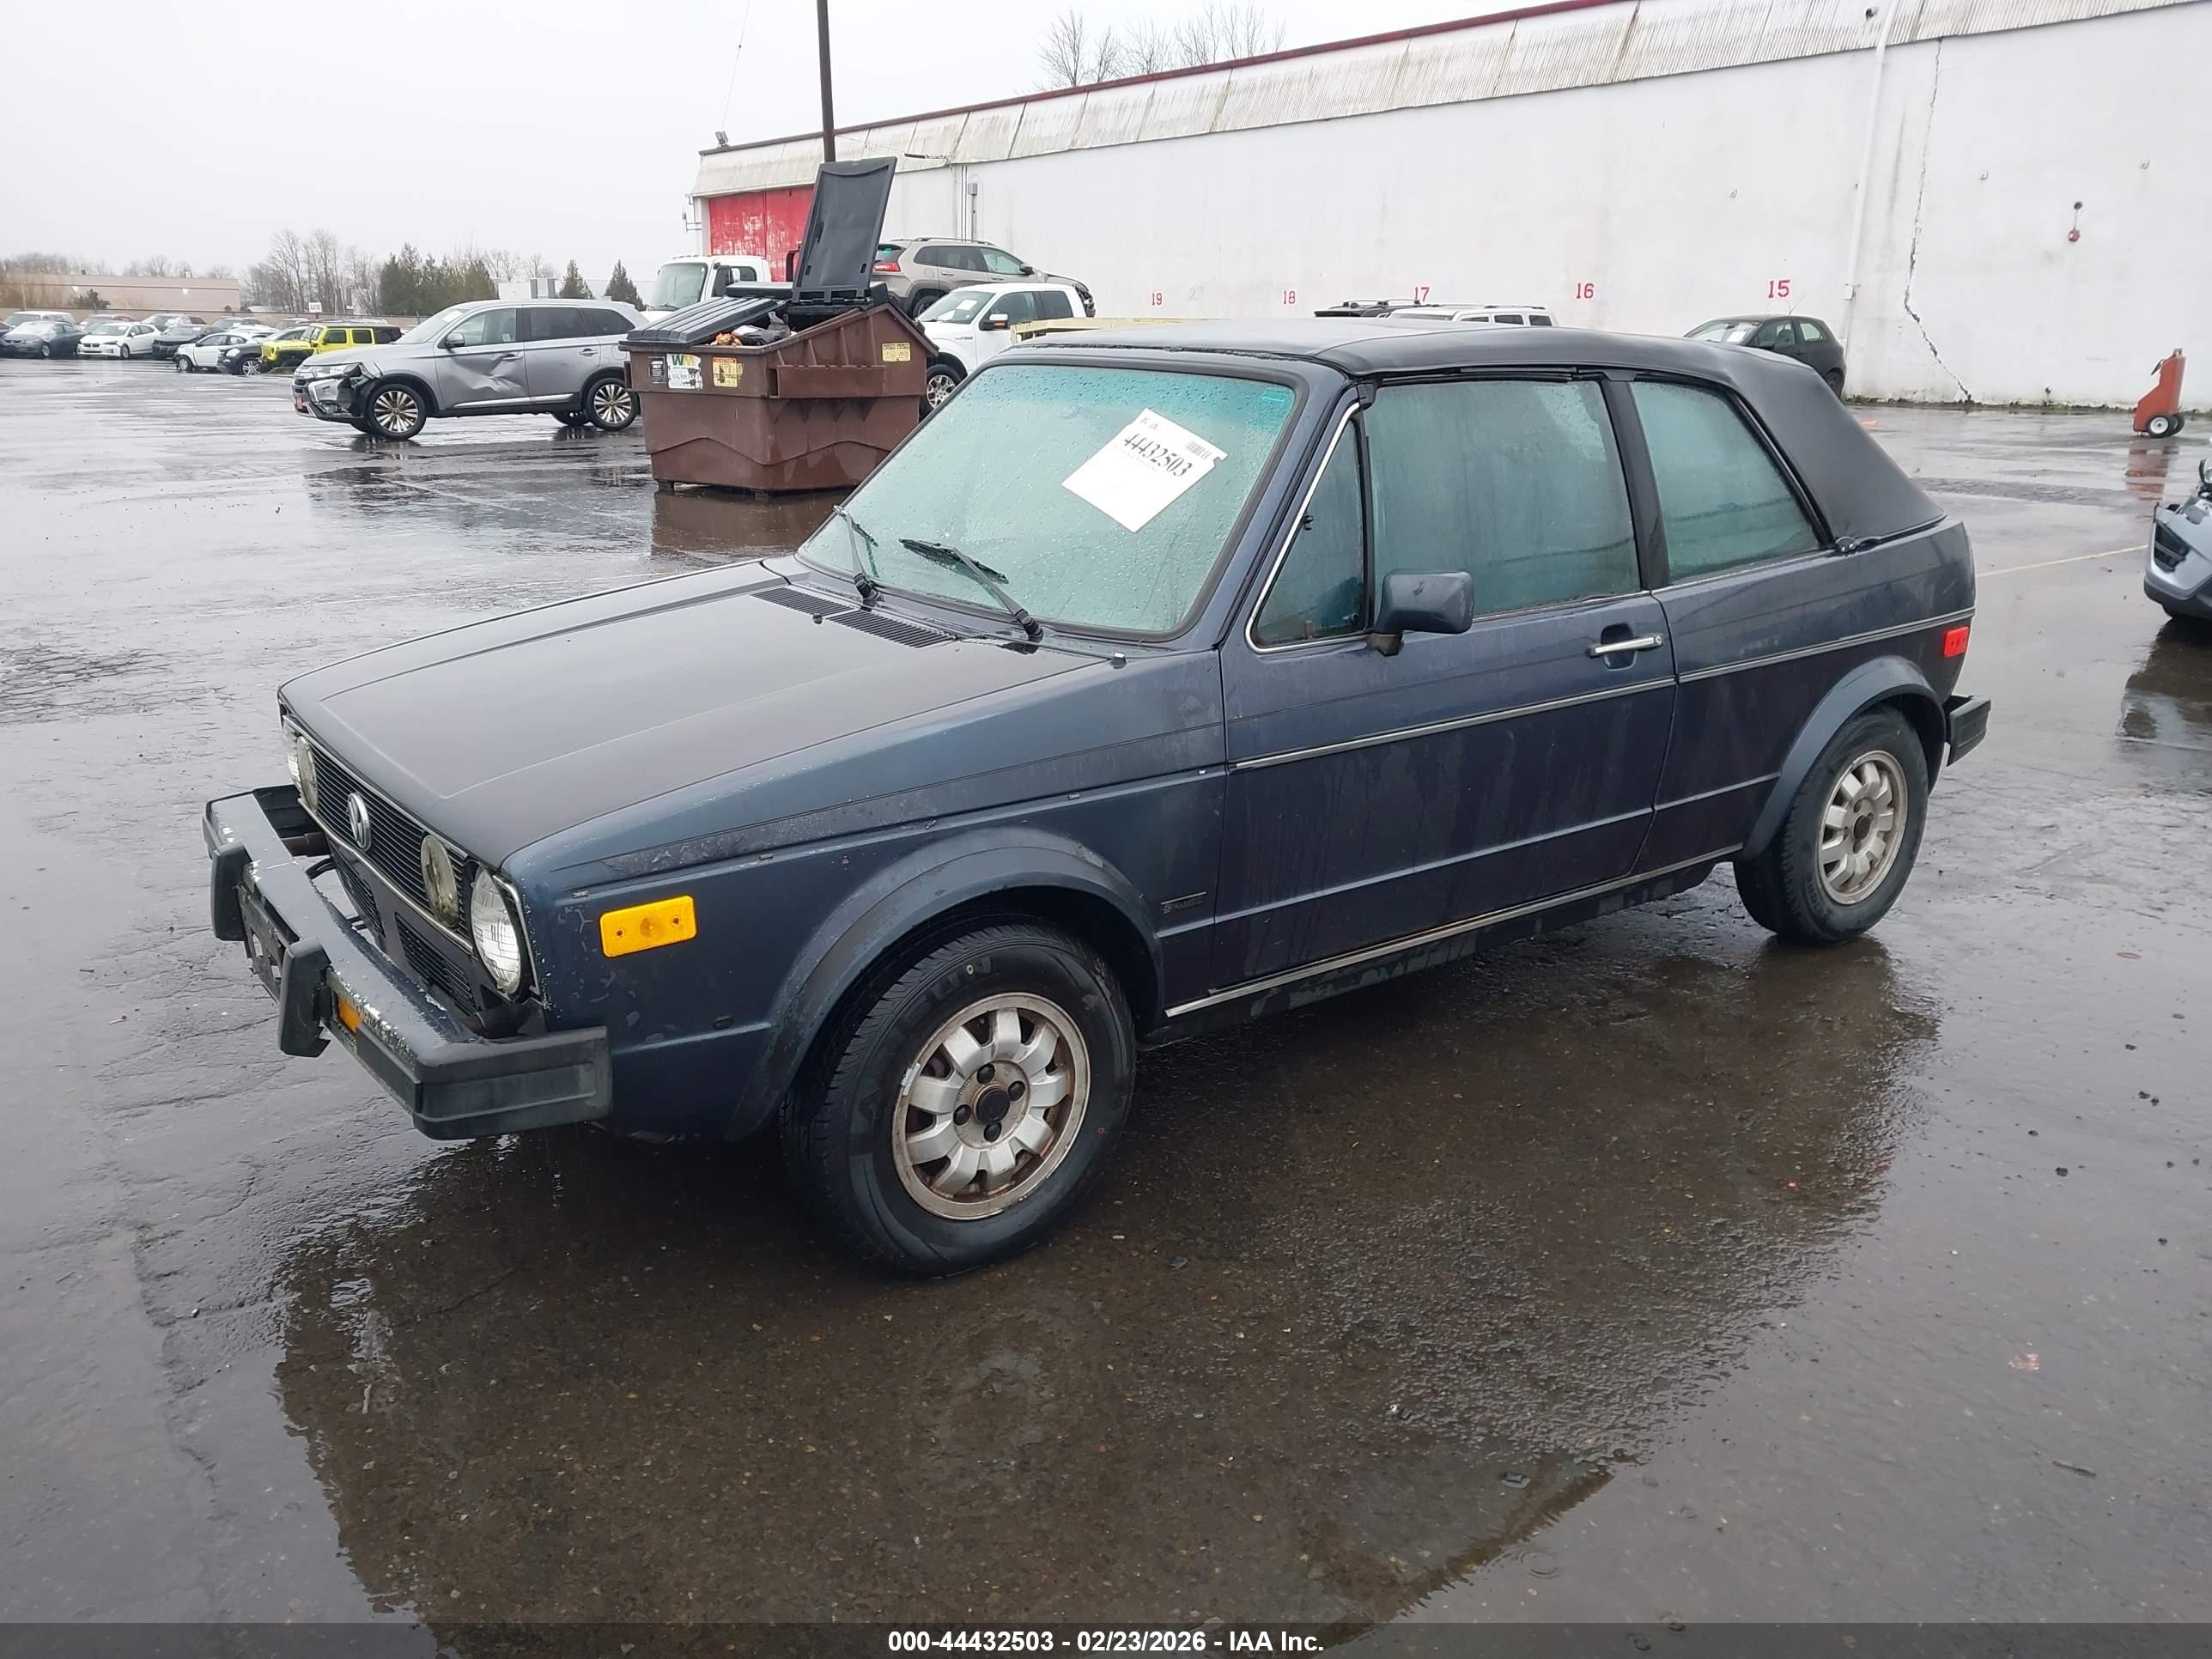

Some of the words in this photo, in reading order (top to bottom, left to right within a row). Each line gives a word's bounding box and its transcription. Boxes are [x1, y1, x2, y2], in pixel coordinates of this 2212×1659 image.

[1414, 287, 1430, 301] 17
[1576, 283, 1595, 299] 16
[1768, 279, 1790, 298] 15
[1152, 292, 1163, 306] 19
[1283, 290, 1297, 305] 18
[1124, 433, 1193, 477] 44432503
